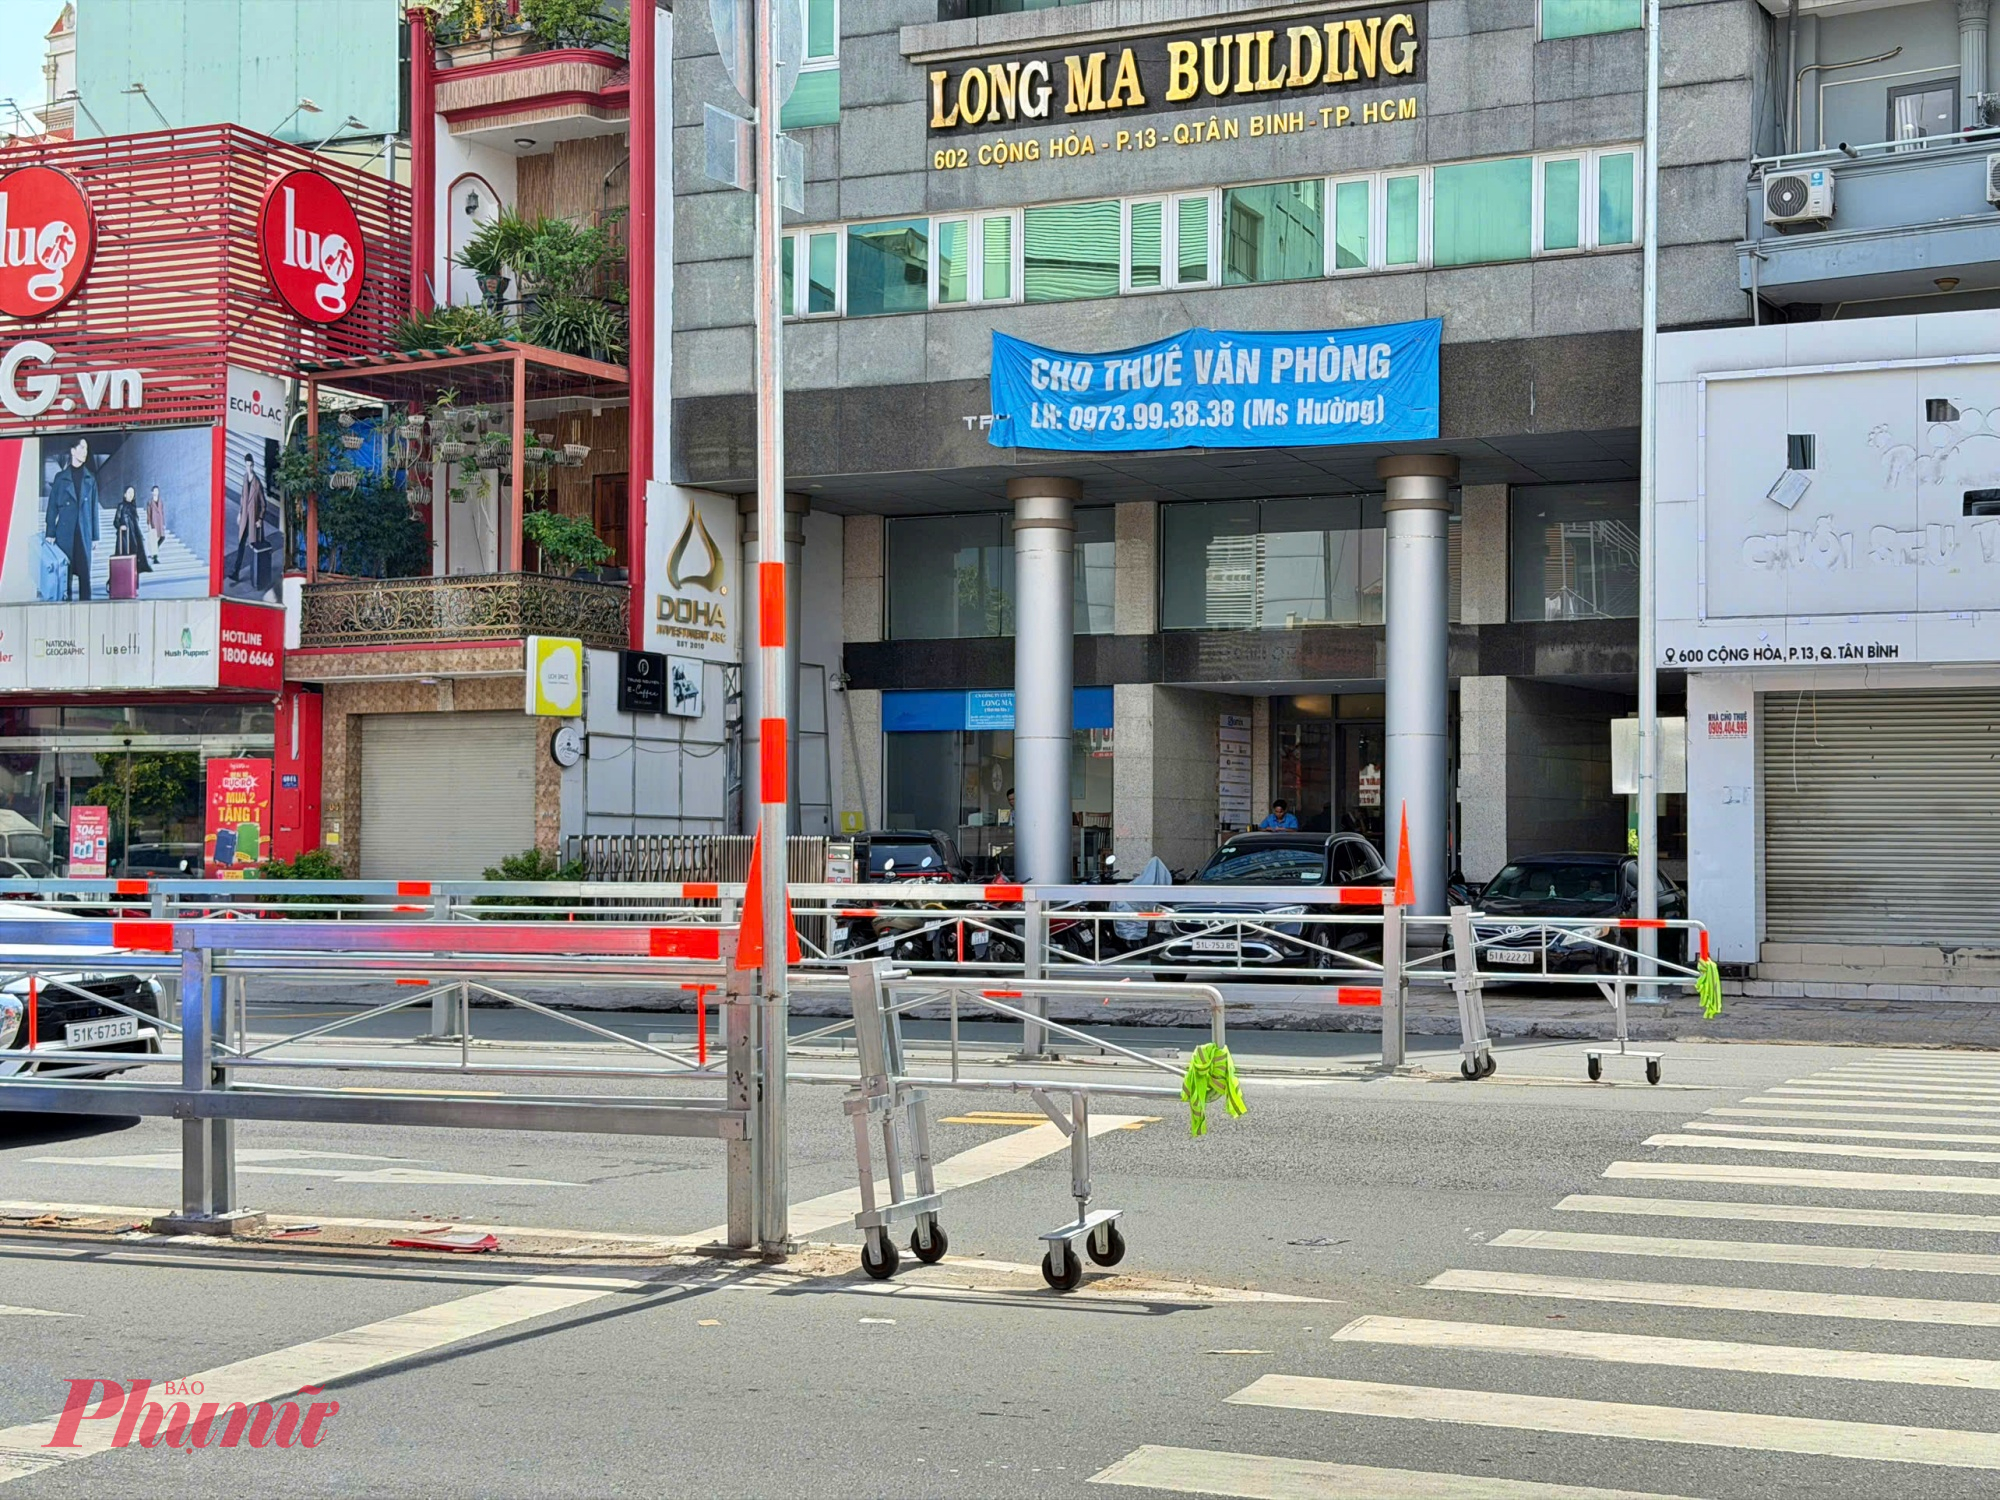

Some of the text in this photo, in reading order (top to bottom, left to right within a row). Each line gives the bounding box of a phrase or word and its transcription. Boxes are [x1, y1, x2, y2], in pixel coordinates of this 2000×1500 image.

[930, 14, 1418, 128] LONG MA BUILDING
[934, 148, 968, 170] 602
[978, 138, 1040, 168] CỘNG
[1050, 129, 1095, 158] HÒA
[1116, 128, 1157, 151] P.13
[1363, 97, 1417, 124] HCM
[283, 186, 354, 314] lug
[1031, 336, 1392, 392] CHO THUÊ VĂN PHÒNG
[230, 394, 282, 421] ECHOLAC
[1031, 393, 1385, 431] LH: 0973.99.38.38 (Ms Hường)
[656, 594, 727, 628] DOHA
[222, 629, 262, 646] HOTLINE
[656, 624, 727, 643] INVESTMENT JSC
[45, 648, 85, 656] GEOGRAPHIC
[183, 649, 209, 659] Puppies
[690, 642, 705, 650] 2010
[1679, 649, 1704, 663] 600
[1707, 645, 1750, 664] CỘNG
[1753, 644, 1786, 663] HÒA,
[1838, 643, 1864, 658] TÂN
[1867, 641, 1899, 659] BÌNH
[222, 647, 275, 668] 1800 6646
[981, 699, 1001, 707] LONG
[1708, 711, 1719, 721] NHÀ
[1708, 721, 1748, 735] 0909.404.999
[226, 792, 256, 804] MUA 2
[218, 803, 260, 825] TẶNG 1
[73, 1021, 132, 1042] 51K-673.63
